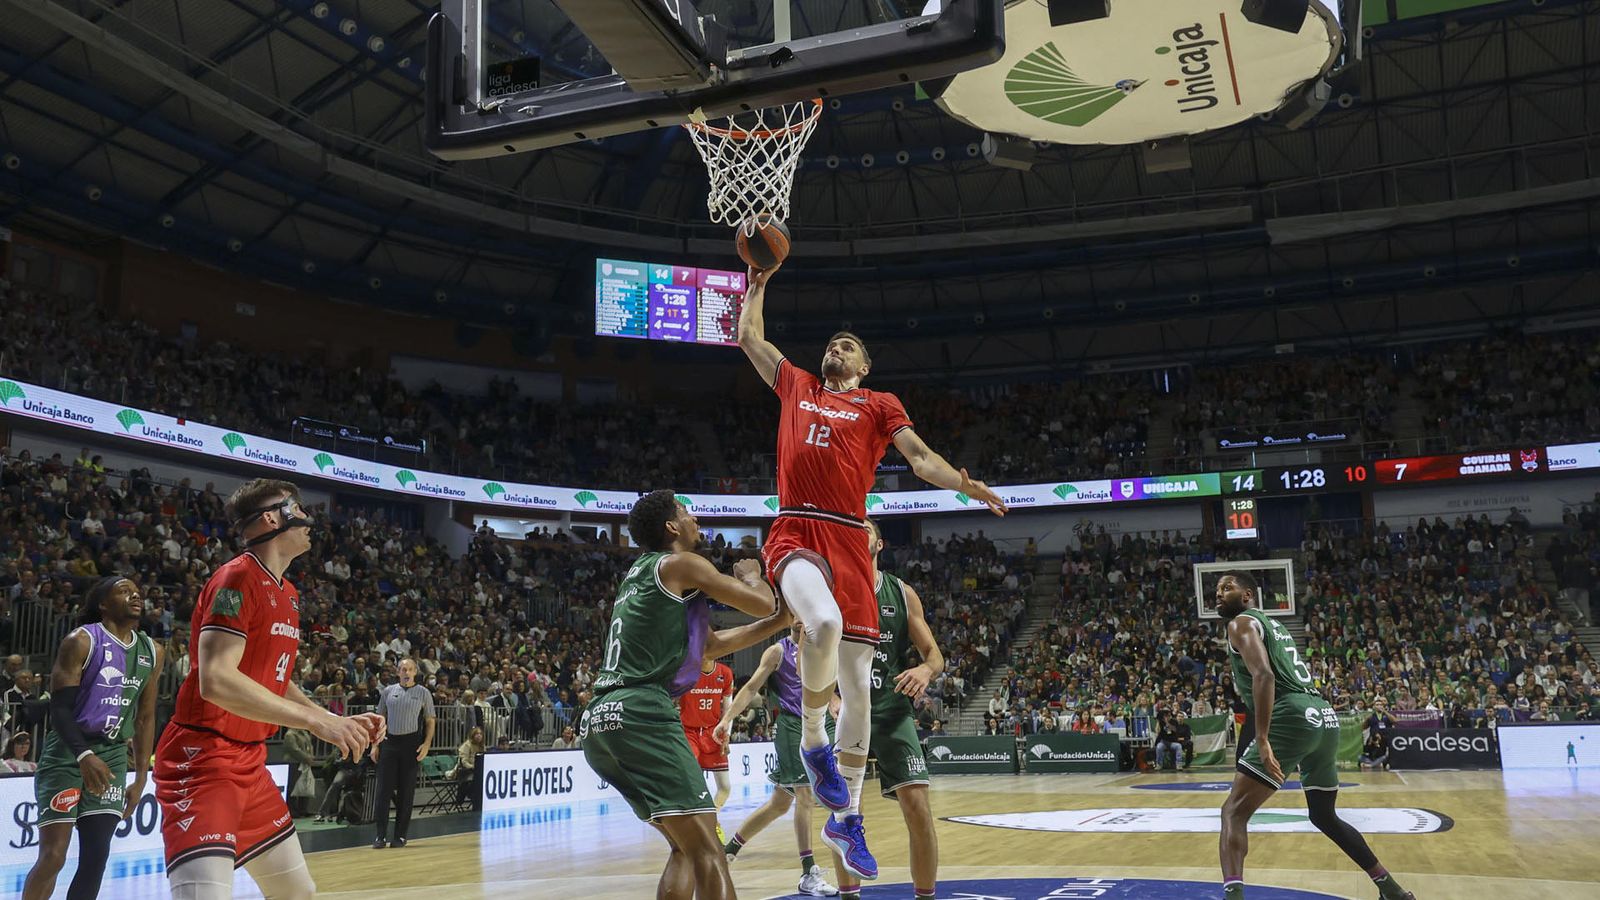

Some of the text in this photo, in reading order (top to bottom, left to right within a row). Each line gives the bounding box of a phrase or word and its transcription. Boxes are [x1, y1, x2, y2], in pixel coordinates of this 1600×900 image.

[1164, 23, 1219, 113] Unicaja
[489, 73, 512, 86] liga
[489, 81, 538, 97] endesa
[655, 268, 669, 280] 14
[681, 270, 690, 281] 7
[23, 399, 94, 425] Unicaja Banco
[142, 426, 203, 447] Unicaja Banco
[805, 423, 831, 448] 12
[244, 447, 297, 467] Unicaja Banco
[1462, 453, 1511, 466] COVIRAN
[333, 467, 380, 484] Unicaja Banco
[1344, 466, 1366, 482] 10
[1394, 463, 1407, 481] 7
[1459, 462, 1512, 475] GRANADA
[1232, 474, 1255, 492] 14
[1280, 469, 1326, 489] 1:28
[415, 482, 466, 497] Unicaja Banco
[1142, 480, 1199, 494] UNICAJA
[504, 493, 557, 506] Unicaja Banco
[1010, 496, 1036, 504] Banco
[1077, 490, 1108, 500] Unicaja
[596, 500, 626, 511] Unicaja
[691, 501, 721, 513] Unicaja
[882, 501, 938, 513] Unicaja Banco
[1231, 500, 1253, 510] 1:28
[1229, 512, 1253, 529] 10
[1284, 646, 1311, 683] 3
[592, 701, 624, 715] COSTA
[699, 698, 713, 710] 32
[591, 712, 623, 725] DEL SOL
[1392, 732, 1489, 752] endesa
[764, 753, 780, 774] SOH
[485, 765, 573, 800] QUE HOTELS
[199, 833, 221, 842] vive
